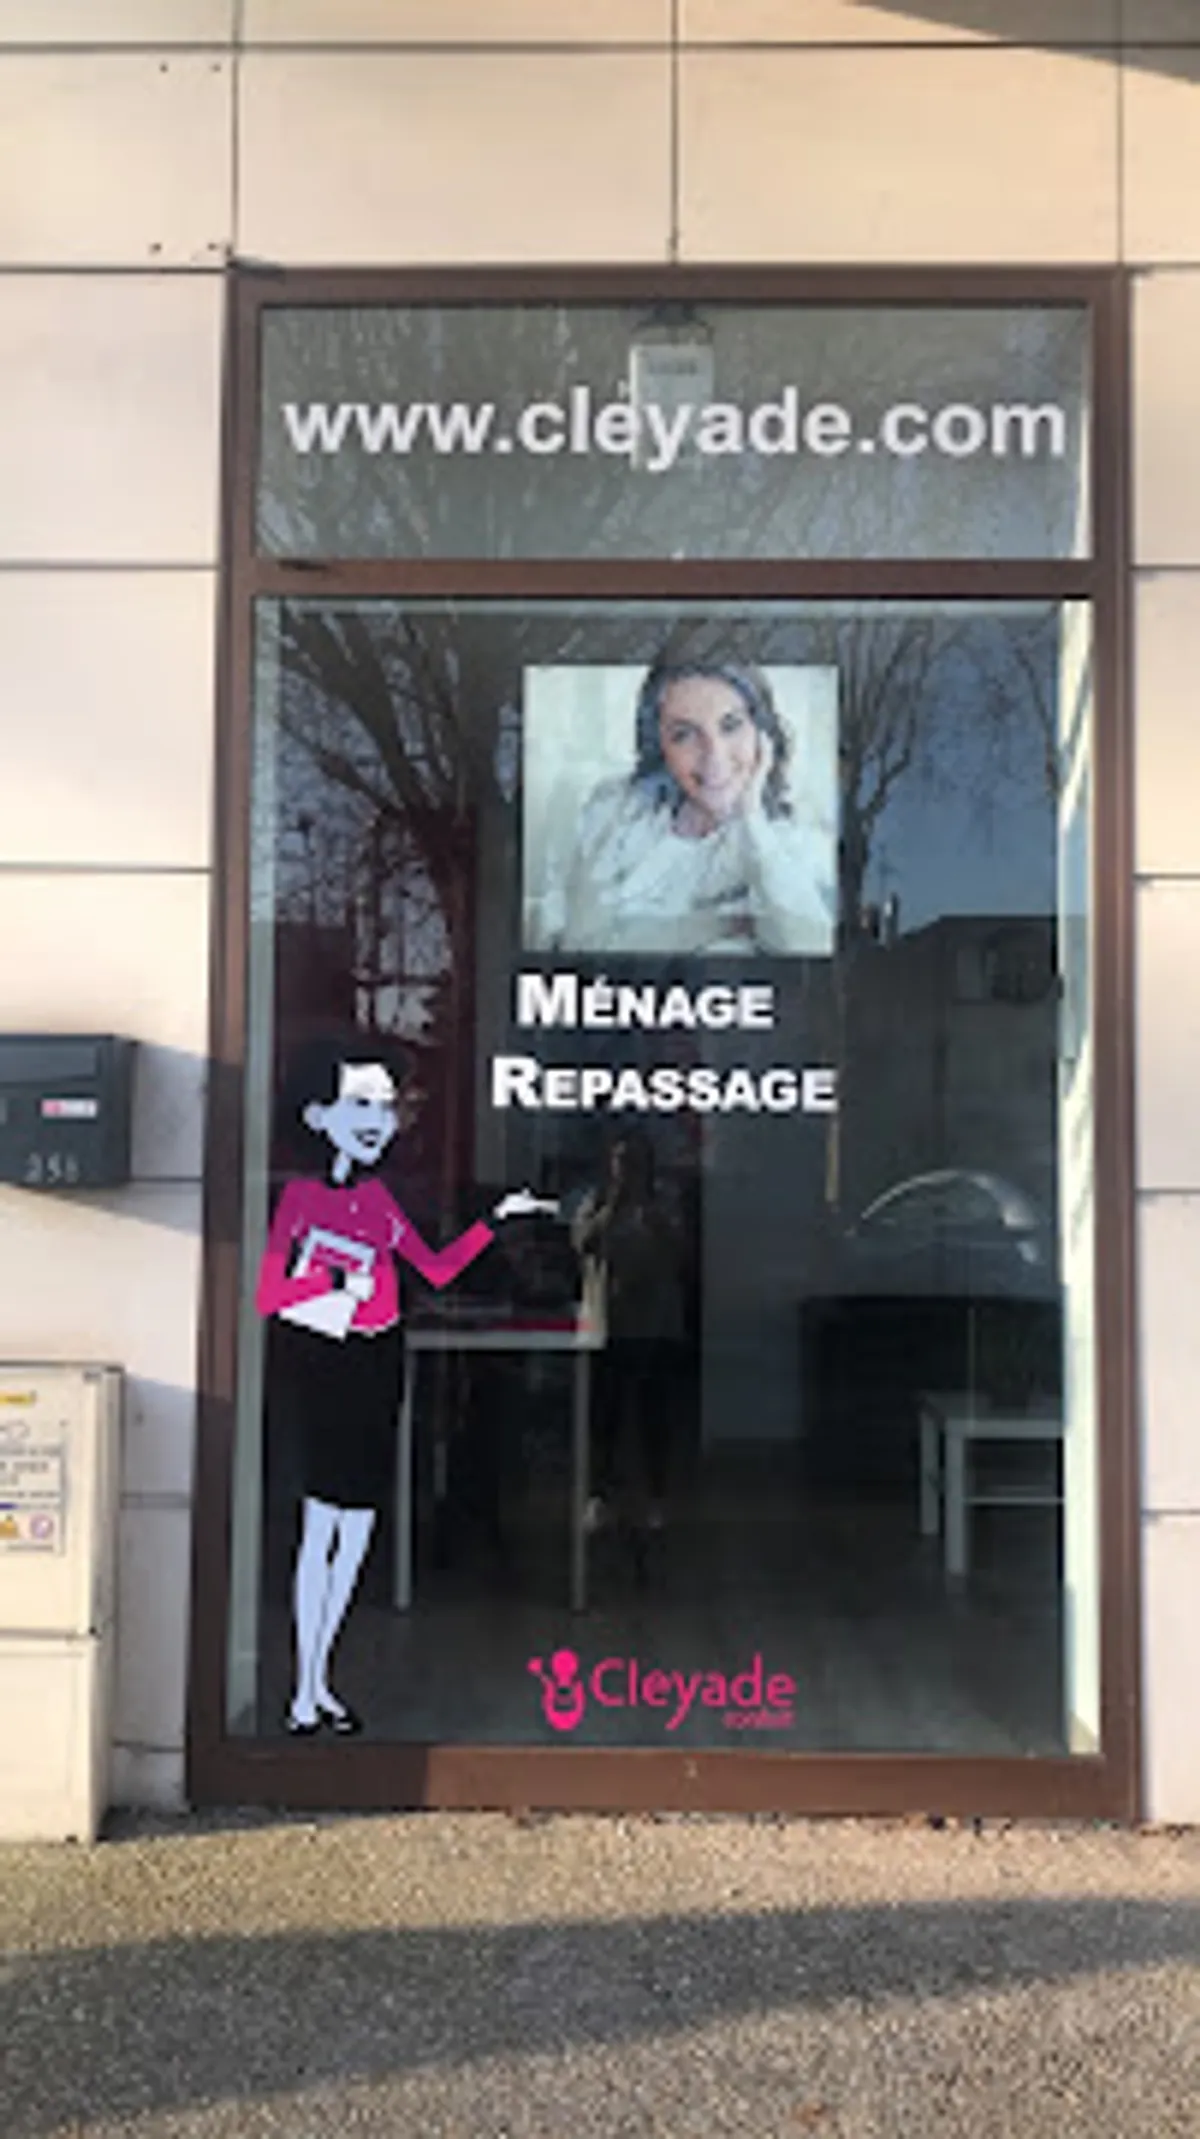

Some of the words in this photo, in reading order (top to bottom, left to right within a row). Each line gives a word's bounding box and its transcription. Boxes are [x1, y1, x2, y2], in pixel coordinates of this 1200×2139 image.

[284, 388, 1066, 471] www.cleyade.com
[516, 973, 775, 1030] MÉNAGE
[491, 1055, 837, 1113] REPASSAGE
[591, 1653, 796, 1730] Cleyade
